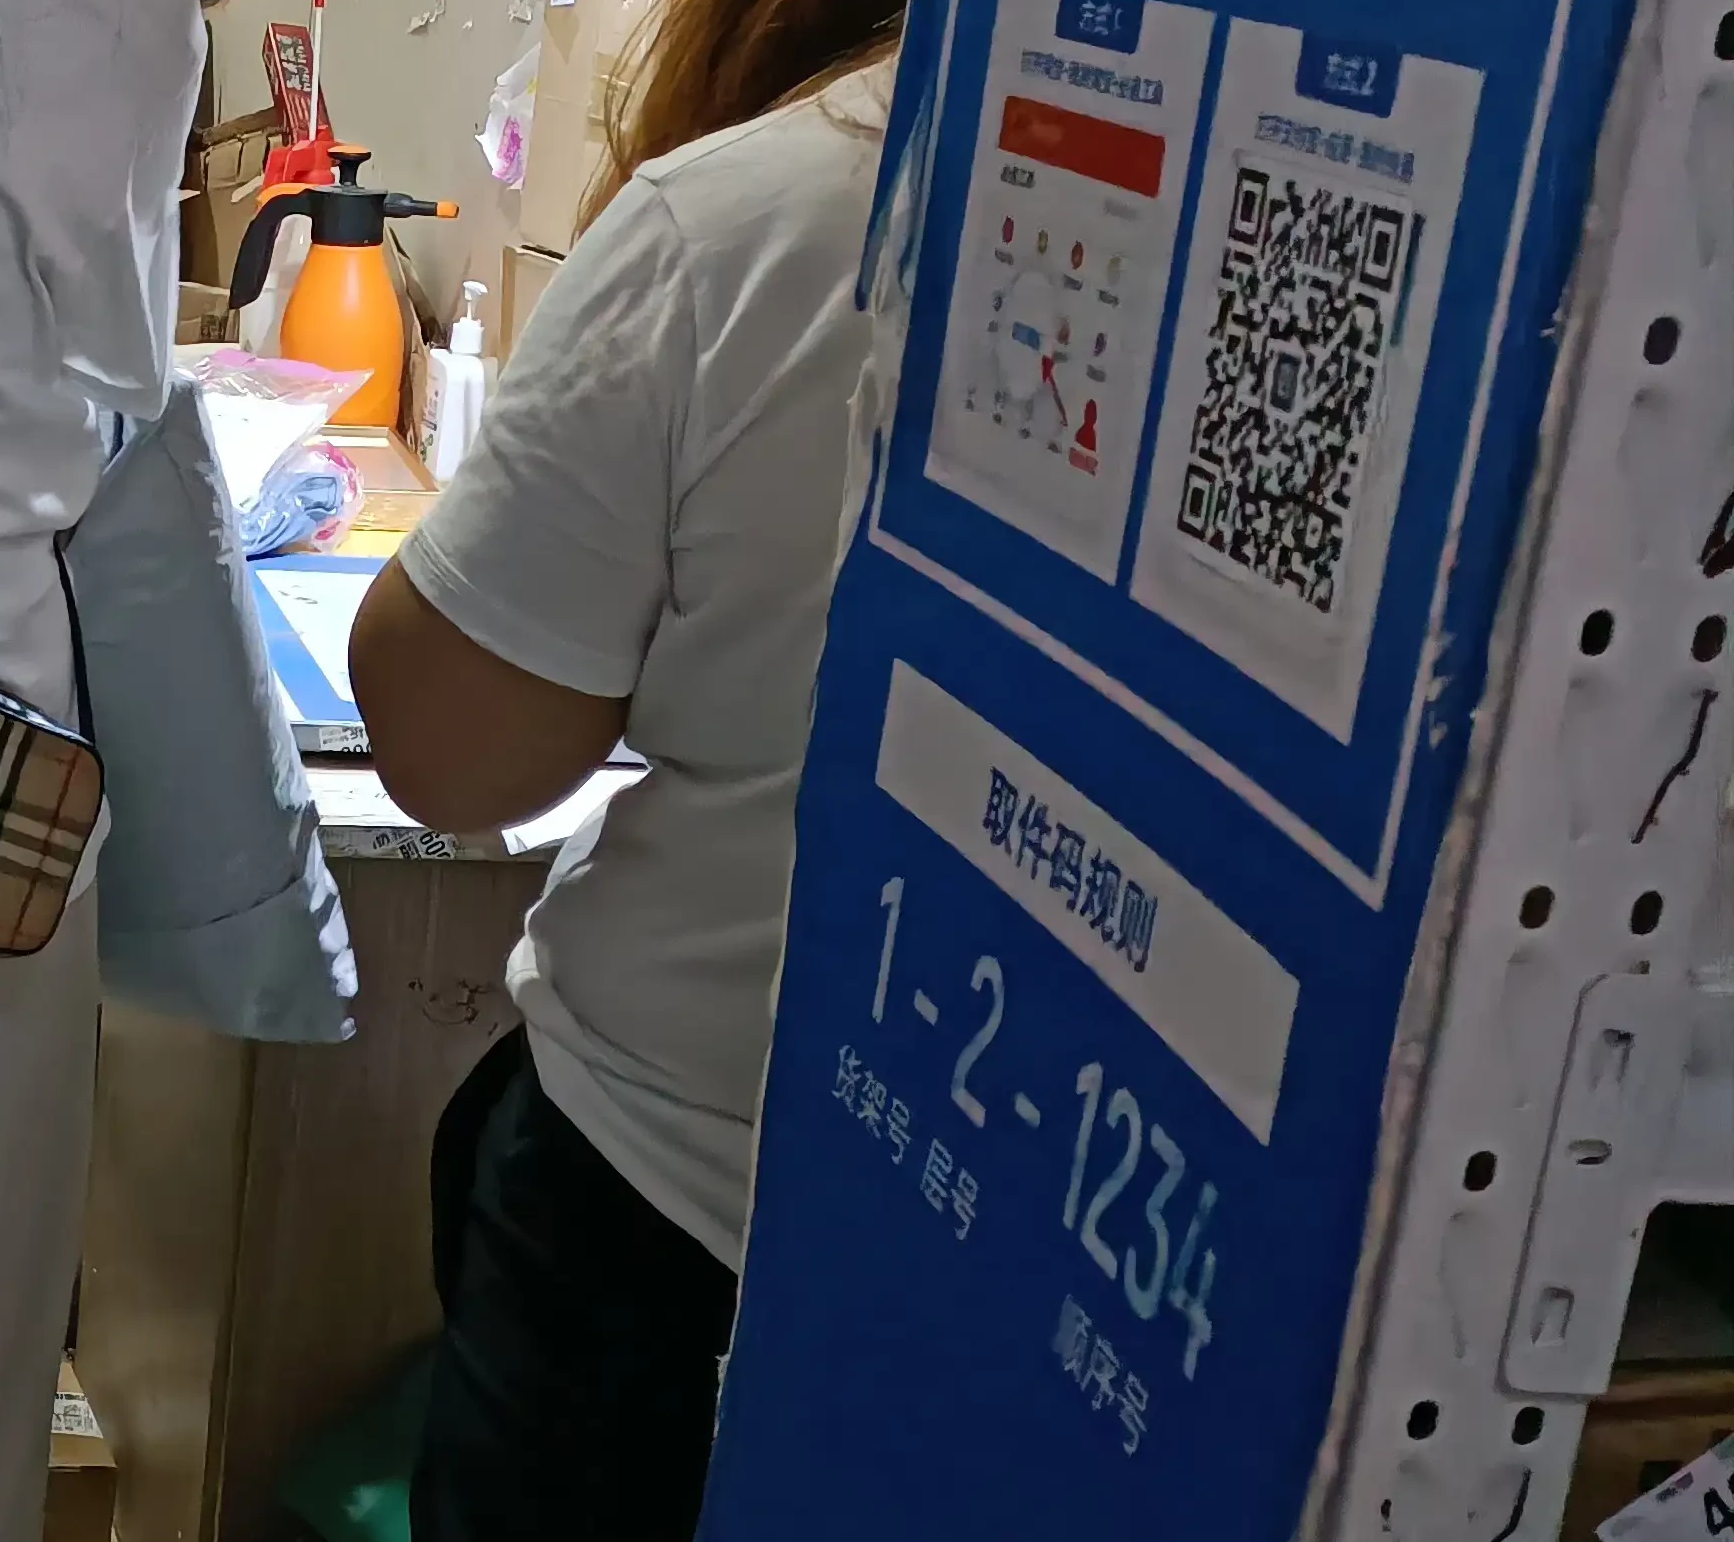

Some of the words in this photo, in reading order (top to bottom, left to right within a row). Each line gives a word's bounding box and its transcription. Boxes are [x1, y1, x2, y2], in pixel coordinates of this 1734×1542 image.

[981, 765, 1161, 977] 取件码规则
